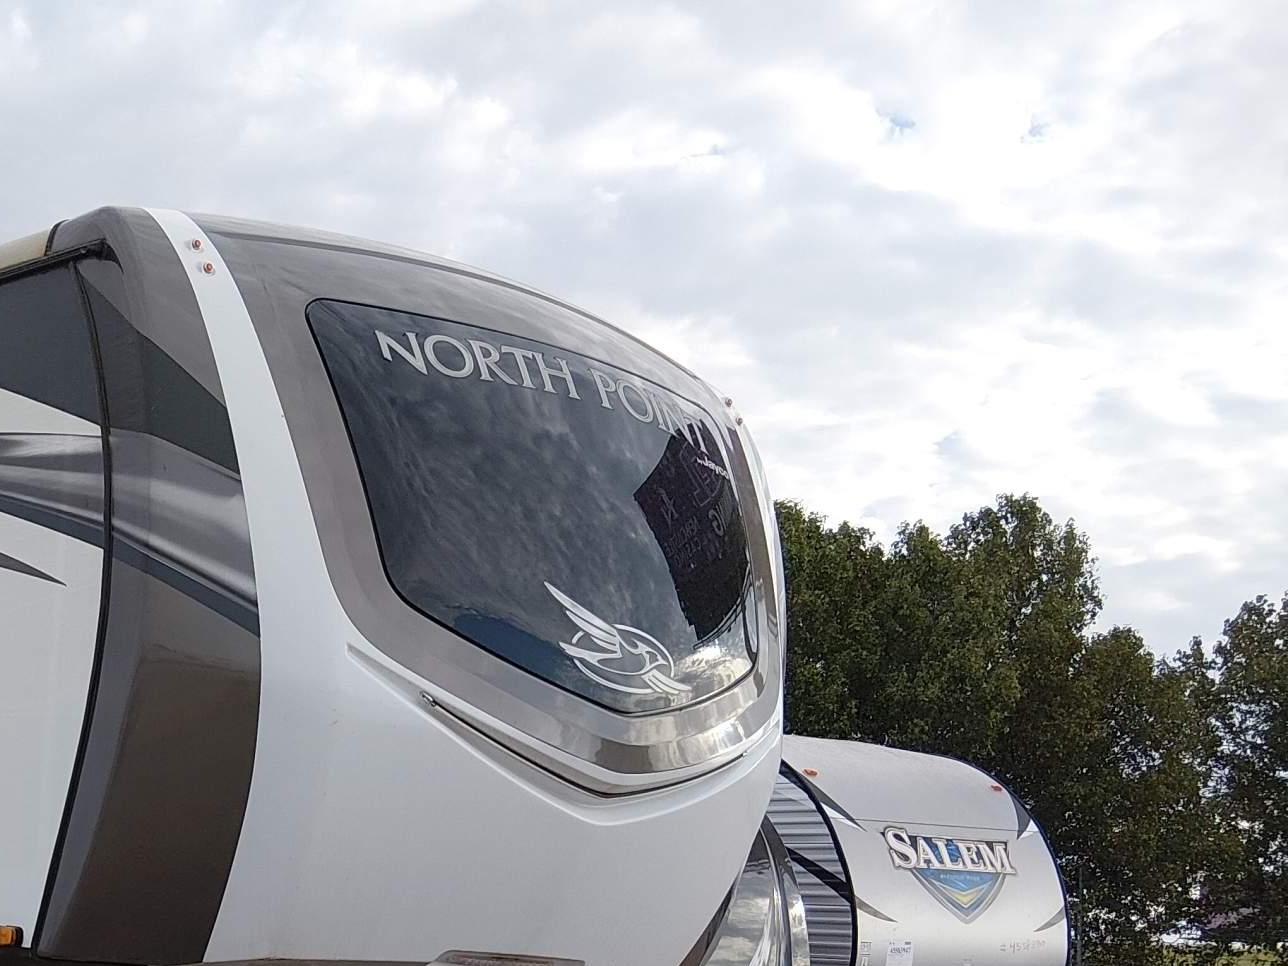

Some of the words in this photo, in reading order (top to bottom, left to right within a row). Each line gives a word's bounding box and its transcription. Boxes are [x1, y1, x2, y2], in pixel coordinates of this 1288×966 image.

[373, 328, 582, 401] NORTH
[587, 367, 711, 456] POINT
[702, 455, 730, 481] Jayco
[884, 826, 1016, 875] SALEM
